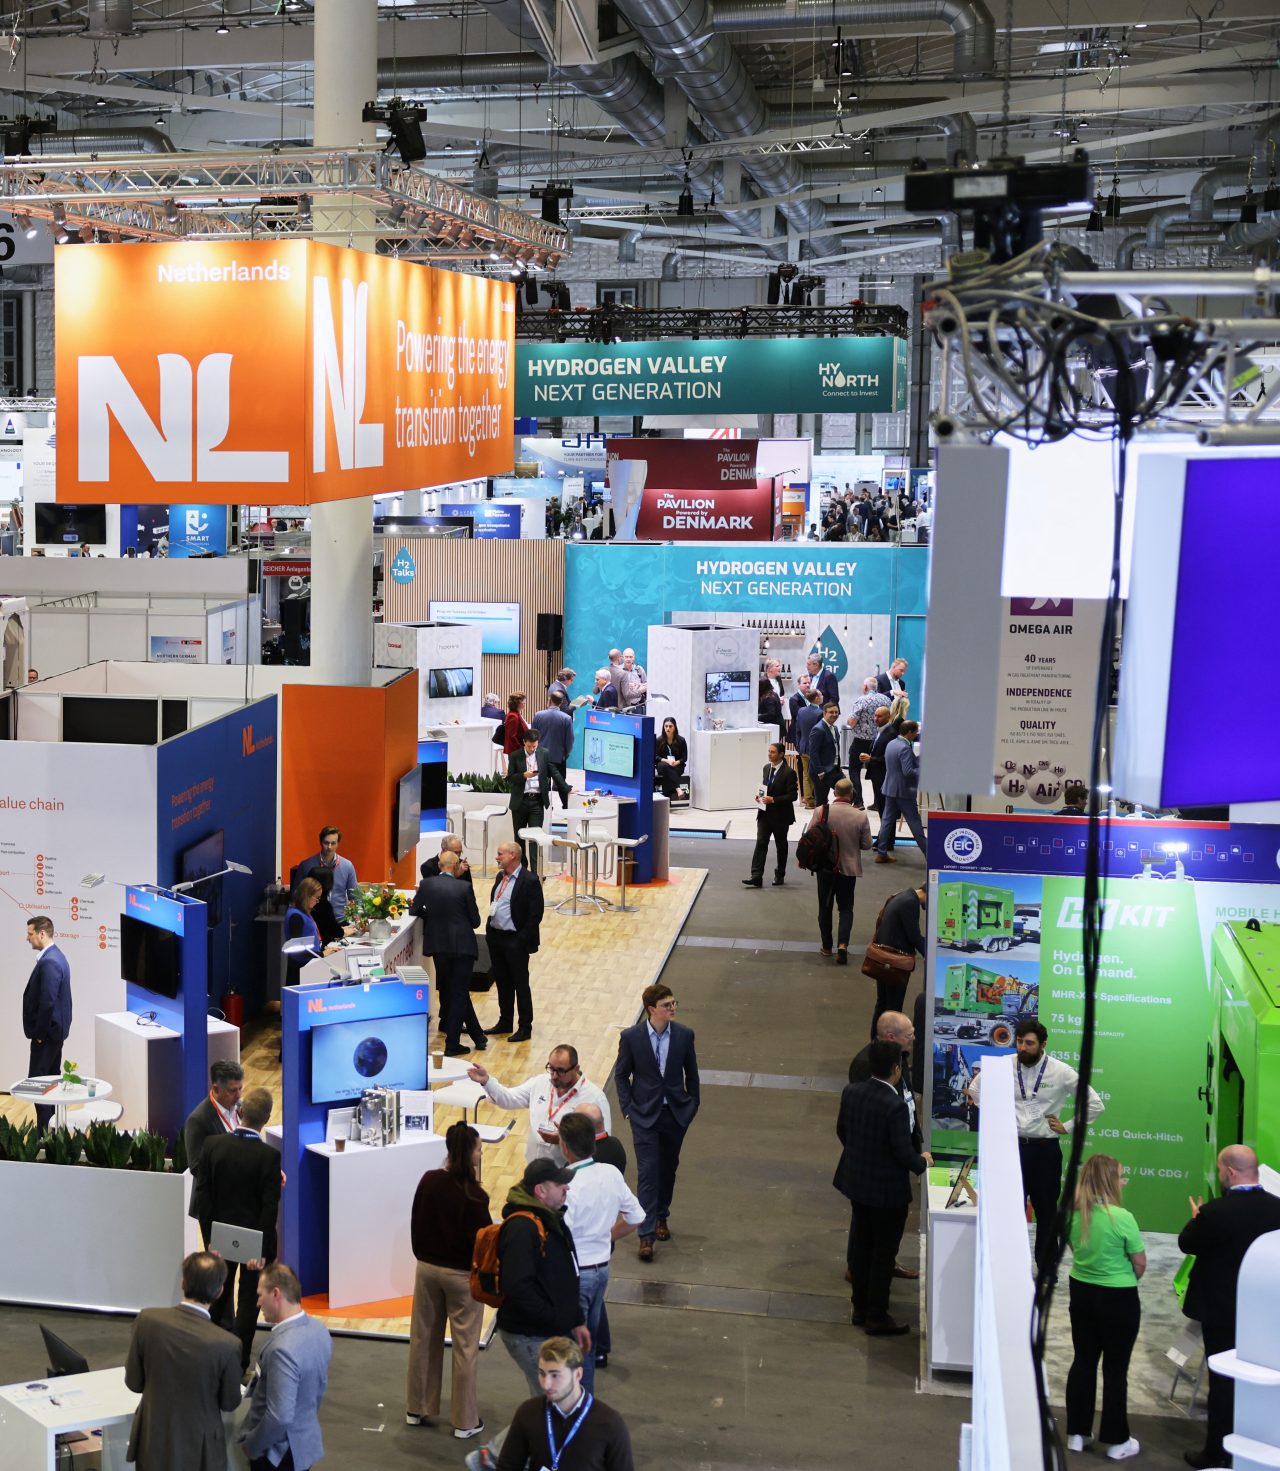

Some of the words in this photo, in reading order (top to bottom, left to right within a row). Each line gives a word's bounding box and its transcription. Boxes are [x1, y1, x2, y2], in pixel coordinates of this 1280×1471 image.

[157, 259, 291, 283] Netherlands
[396, 315, 456, 390] Powering
[458, 319, 475, 375] the
[477, 338, 510, 389] energy
[528, 357, 641, 377] HYDROGEN
[646, 355, 728, 374] VALLEY
[818, 362, 840, 375] HY
[312, 275, 384, 474] NL
[534, 383, 587, 403] NEXT
[592, 381, 721, 401] GENERATION
[78, 352, 289, 483] NL
[395, 388, 456, 449] transition
[458, 388, 502, 457] together
[716, 453, 750, 462] PAVILION
[656, 500, 715, 510] PAVILION
[662, 516, 754, 530] DENMARK
[398, 560, 410, 569] H2
[696, 561, 788, 576] HYDROGEN
[792, 562, 856, 577] VALLEY
[392, 569, 414, 577] Talks
[700, 581, 744, 596] NEXT
[747, 581, 852, 597] GENERATION
[1010, 624, 1050, 634] OMEGA
[1052, 625, 1072, 634] AIR
[818, 647, 837, 662] H2
[1024, 654, 1036, 663] 40
[1006, 688, 1072, 698] INDEPENDENCE
[1020, 720, 1056, 730] QUALITY
[1004, 760, 1016, 770] O2
[1022, 764, 1036, 775] N2
[1008, 779, 1025, 792] H2
[29, 797, 64, 811] chain
[953, 840, 972, 851] EIC
[1216, 906, 1270, 919] MOBILE
[1052, 964, 1072, 975] On
[416, 990, 423, 1000] 6
[1100, 992, 1172, 1005] Specifications
[1051, 1013, 1064, 1022] 75
[1068, 1014, 1082, 1026] kg
[1088, 1128, 1095, 1136] &
[1098, 1129, 1120, 1138] JCB
[1122, 1130, 1184, 1142] Quick-Hitch
[1140, 1168, 1155, 1176] UK
[1158, 1168, 1182, 1178] CDG
